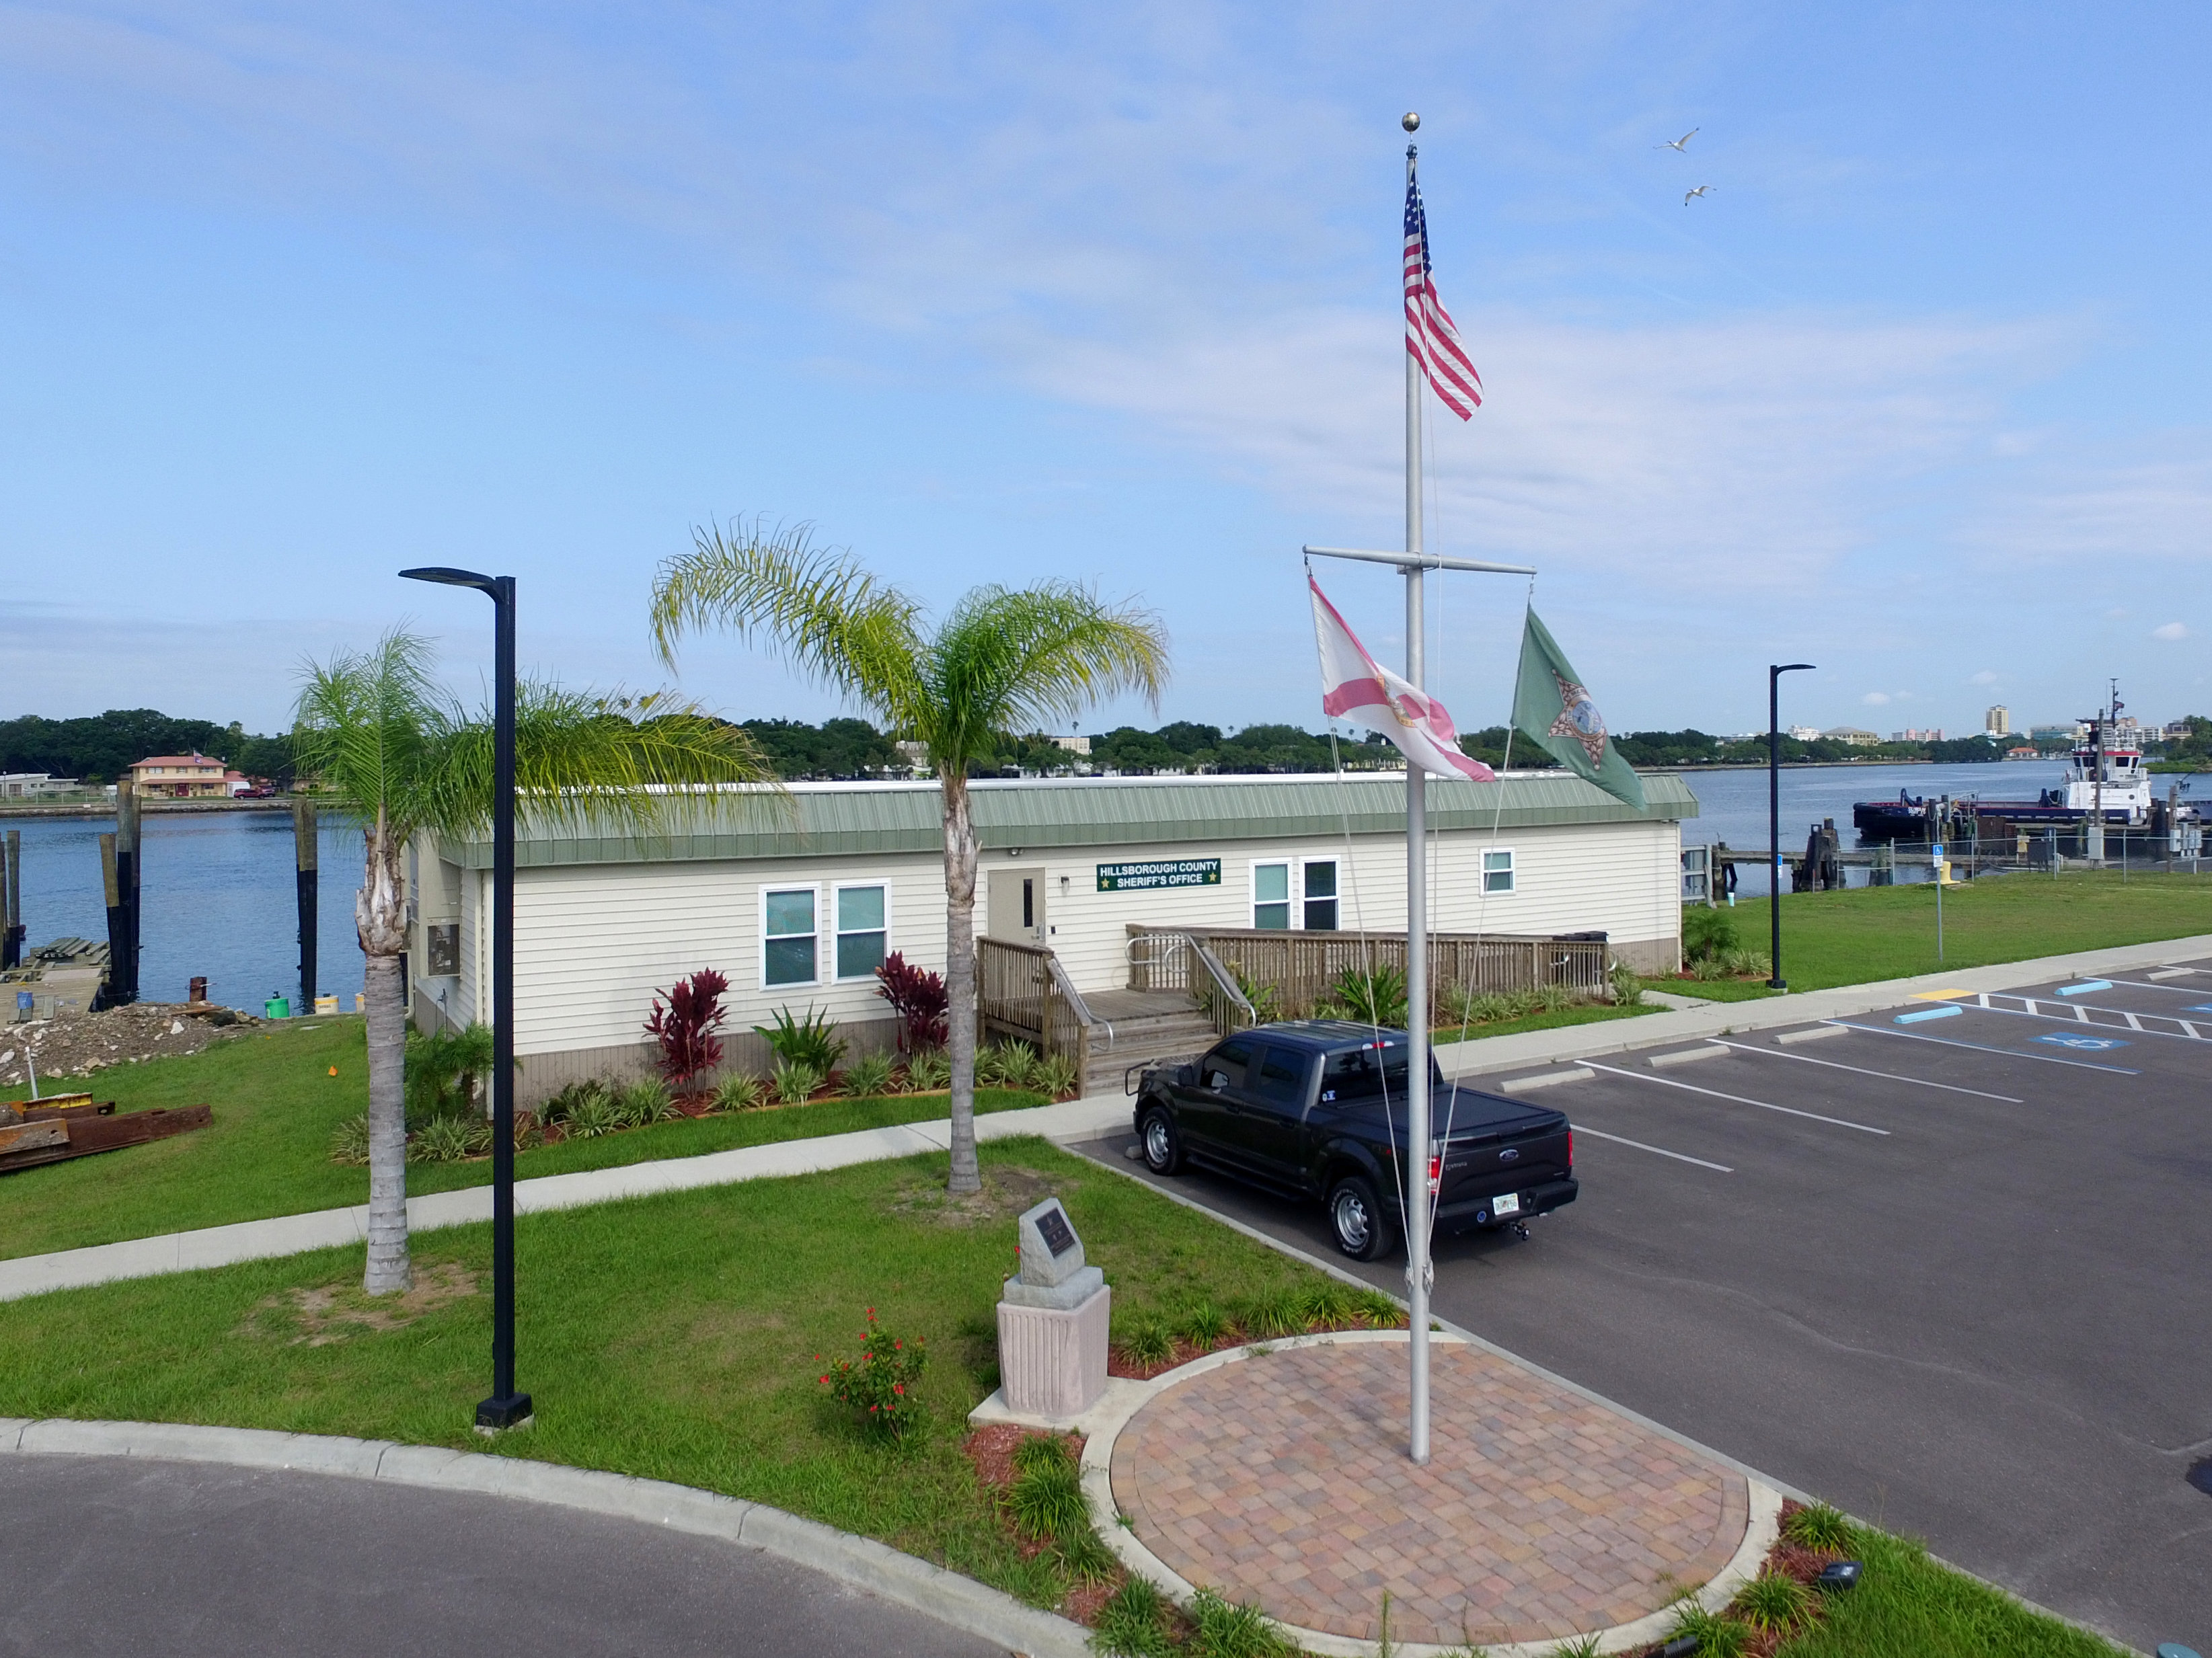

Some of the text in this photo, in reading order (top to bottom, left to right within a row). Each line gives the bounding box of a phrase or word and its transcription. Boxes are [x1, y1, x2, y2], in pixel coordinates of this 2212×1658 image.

[1100, 861, 1218, 876] HILLSBOROUGH COUNTY
[1117, 873, 1203, 887] SHERIFF'S OFFICE
